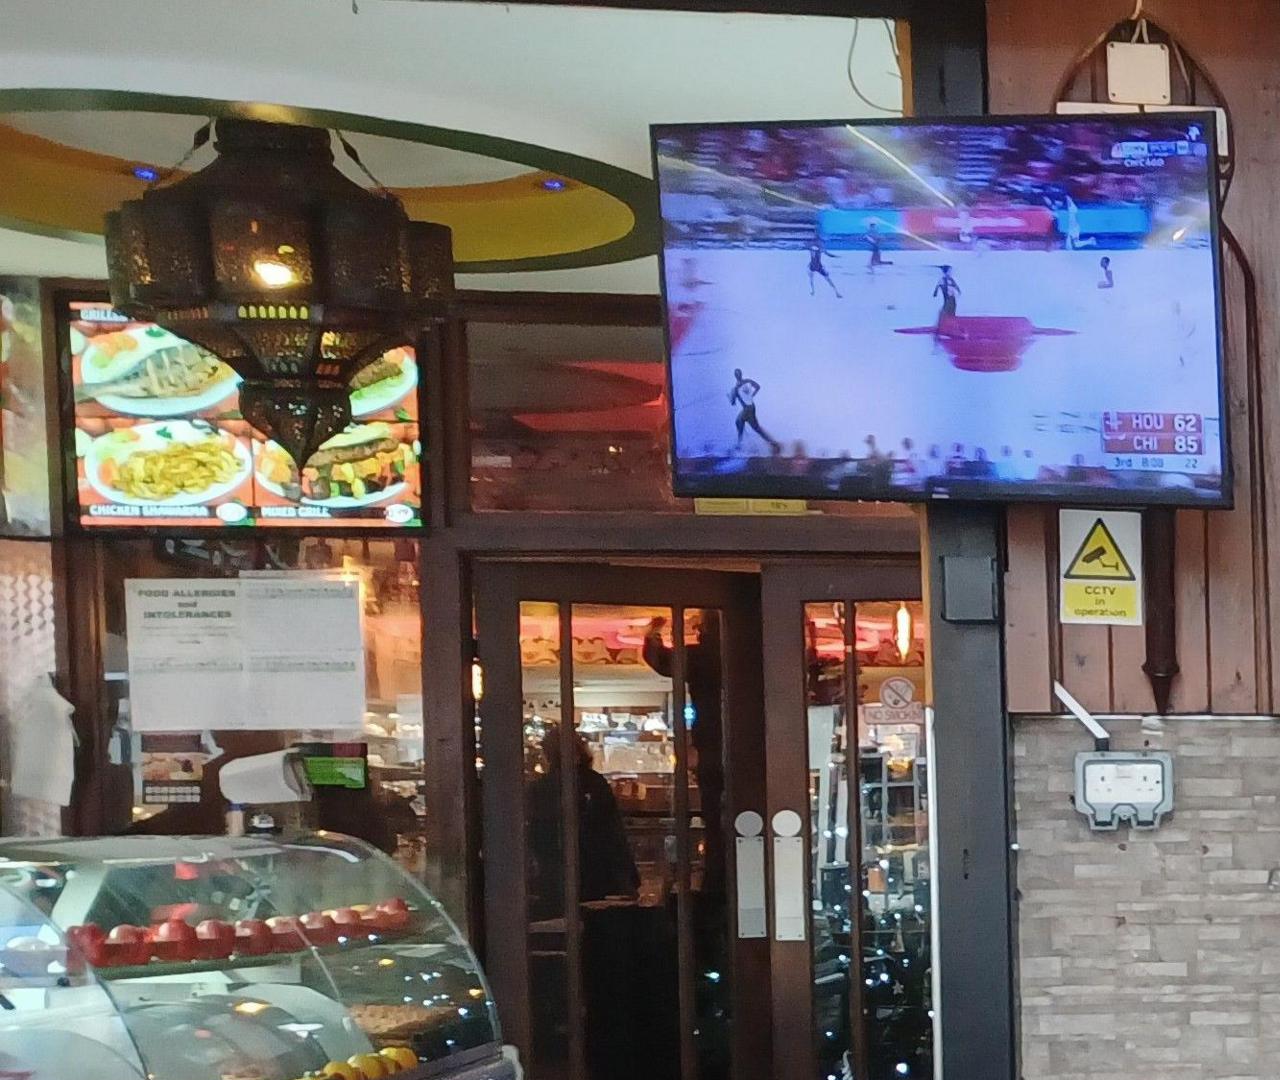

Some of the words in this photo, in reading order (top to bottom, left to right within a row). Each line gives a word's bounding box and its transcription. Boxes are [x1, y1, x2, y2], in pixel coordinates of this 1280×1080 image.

[1132, 413, 1164, 430] HOU
[1174, 414, 1196, 432] 62
[1133, 435, 1158, 451] CHI
[1174, 435, 1198, 453] 85
[1114, 457, 1133, 467] 3rd
[1184, 458, 1198, 469] 22
[138, 589, 168, 597] FOOD
[173, 589, 236, 597] ALLERGIES
[1084, 586, 1116, 595] CCTV
[1094, 598, 1105, 606] in
[143, 610, 232, 619] INTOLERANCES
[1074, 608, 1127, 617] operation
